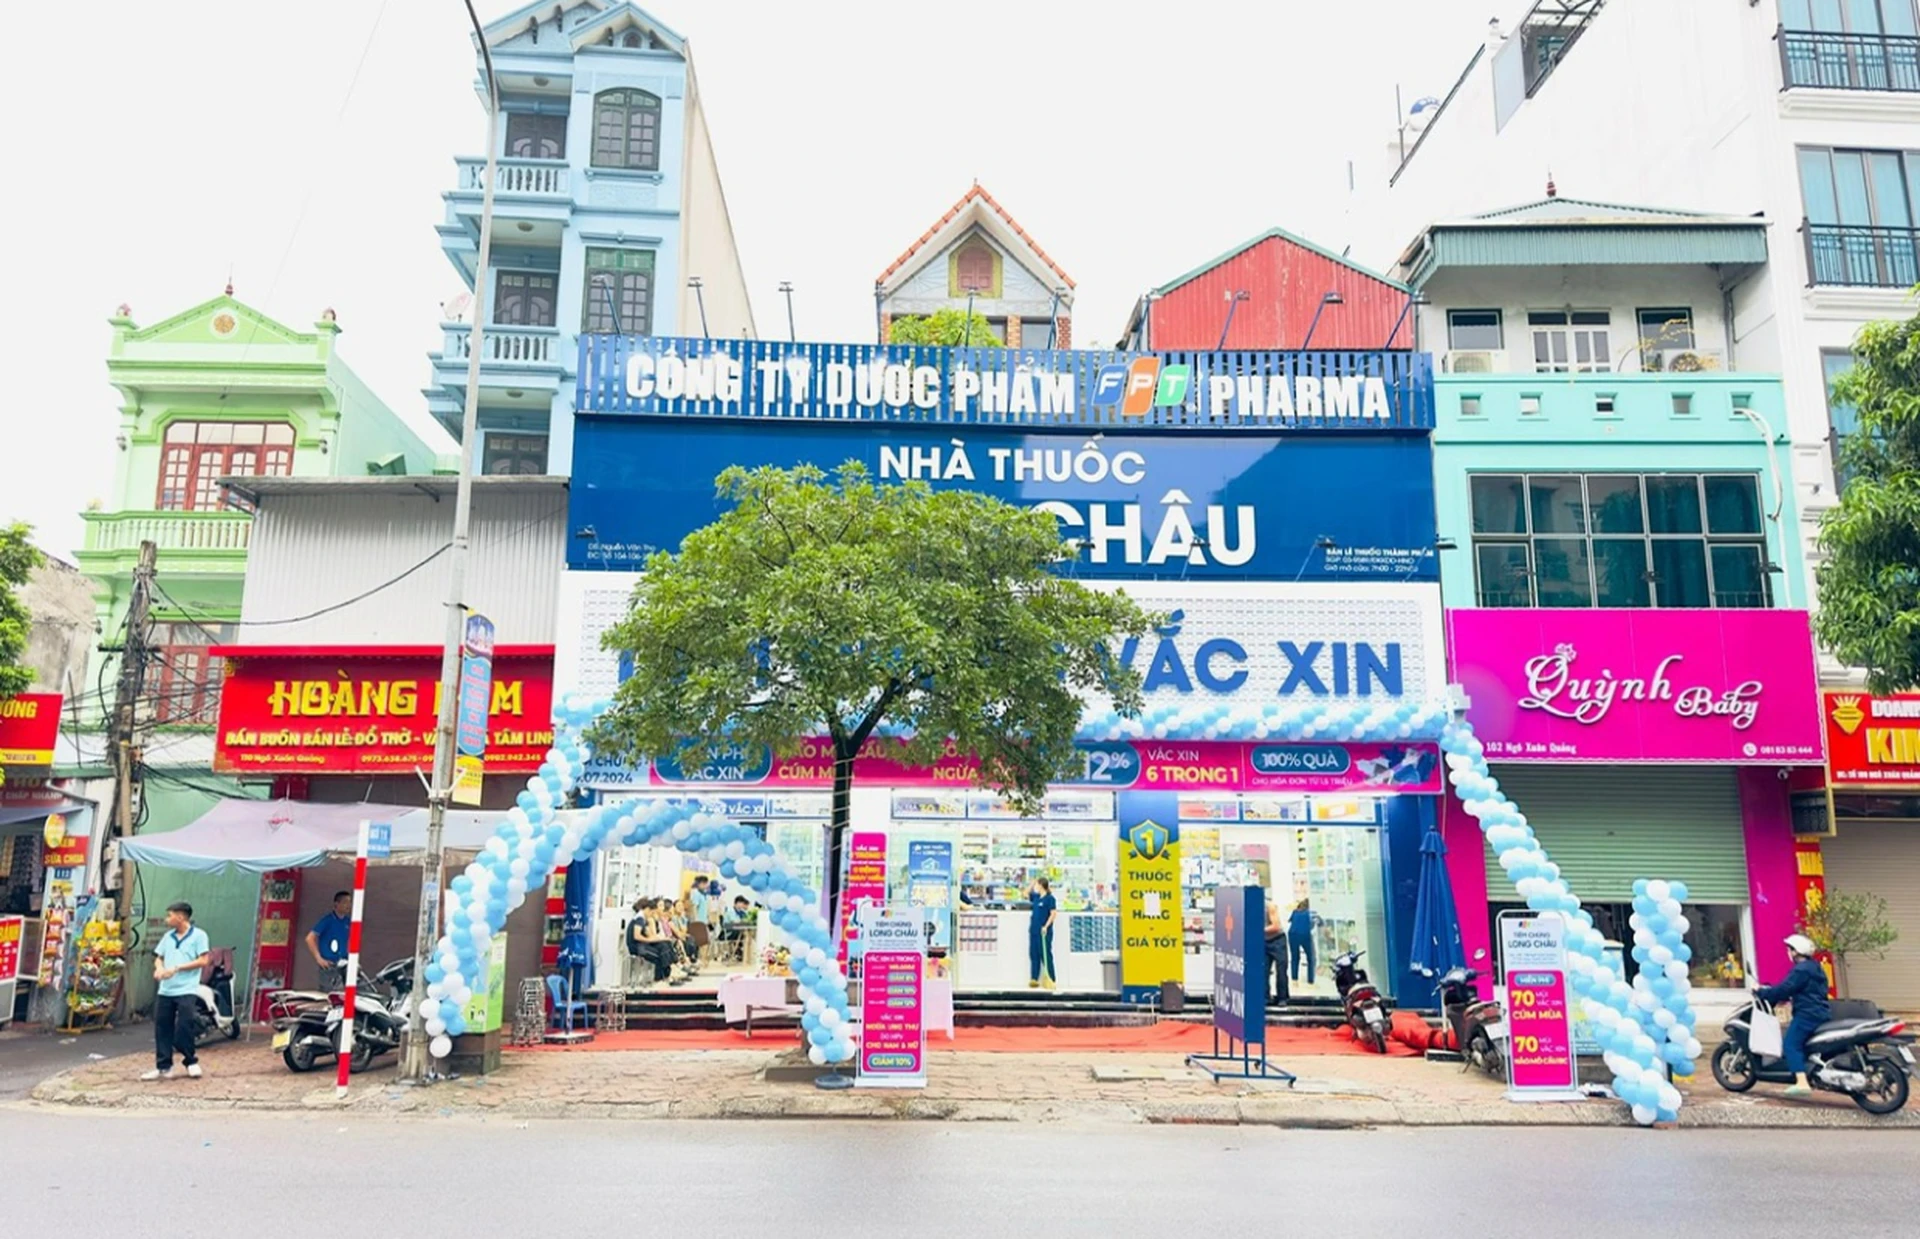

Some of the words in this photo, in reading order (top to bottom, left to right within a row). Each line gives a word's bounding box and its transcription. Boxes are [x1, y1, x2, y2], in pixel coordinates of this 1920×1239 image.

[626, 346, 743, 402] CÔNG
[826, 356, 941, 416] DƯỢC
[954, 356, 1075, 414] PHẨM
[1098, 371, 1186, 398] FPT
[1210, 375, 1391, 418] PHARMA
[880, 439, 974, 481] NHÀ
[990, 434, 1146, 484] THUỐC
[1031, 489, 1256, 566] CHÂU
[1277, 641, 1403, 696] XIN
[267, 668, 417, 716] HOÀNG
[1518, 650, 1683, 724] Quỳnh
[1674, 681, 1762, 729] Baby
[225, 727, 257, 746] BÁN
[259, 728, 300, 746] BUÔN
[303, 727, 333, 746] BÁN
[494, 730, 523, 745] TÂM
[1147, 746, 1175, 761] VẮC
[1178, 749, 1199, 762] XIN
[1262, 752, 1301, 768] 100%
[1303, 748, 1339, 769] QUÀ
[717, 766, 745, 779] XIN
[778, 763, 820, 779] CÚM
[933, 763, 978, 779] NGỪA
[1146, 767, 1158, 780] 6
[1161, 766, 1227, 782] TRONG
[1229, 768, 1238, 783] 1
[1140, 829, 1154, 855] 1
[1128, 868, 1173, 881] THUỐC
[1132, 909, 1170, 920] HG
[869, 929, 892, 937] LONG
[894, 927, 918, 937] CHÂU
[1126, 935, 1149, 947] GIÁ
[1152, 934, 1178, 947] TỐT
[1533, 939, 1557, 948] CHÂU
[1511, 990, 1535, 1007] 70
[1512, 1008, 1536, 1020] CÚM
[1538, 1008, 1563, 1020] MÙA
[1514, 1036, 1539, 1053] 70
